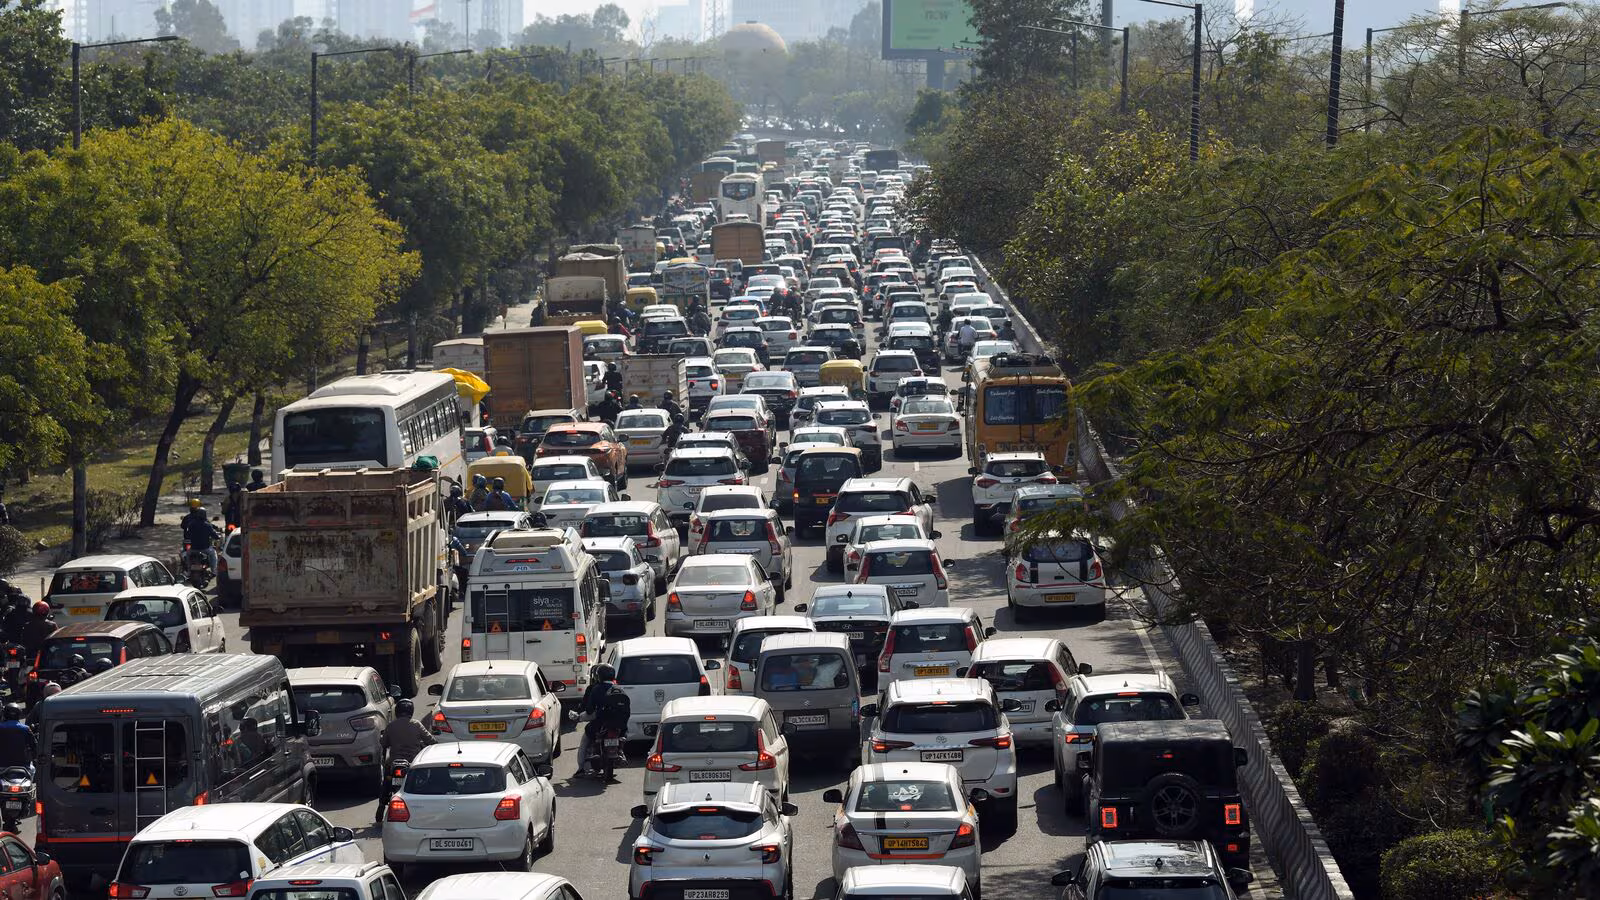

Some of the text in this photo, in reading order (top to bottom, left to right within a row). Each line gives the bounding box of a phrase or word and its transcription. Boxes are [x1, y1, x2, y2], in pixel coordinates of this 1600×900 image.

[533, 596, 550, 606] siya
[436, 838, 472, 848] DL 5CU 0461
